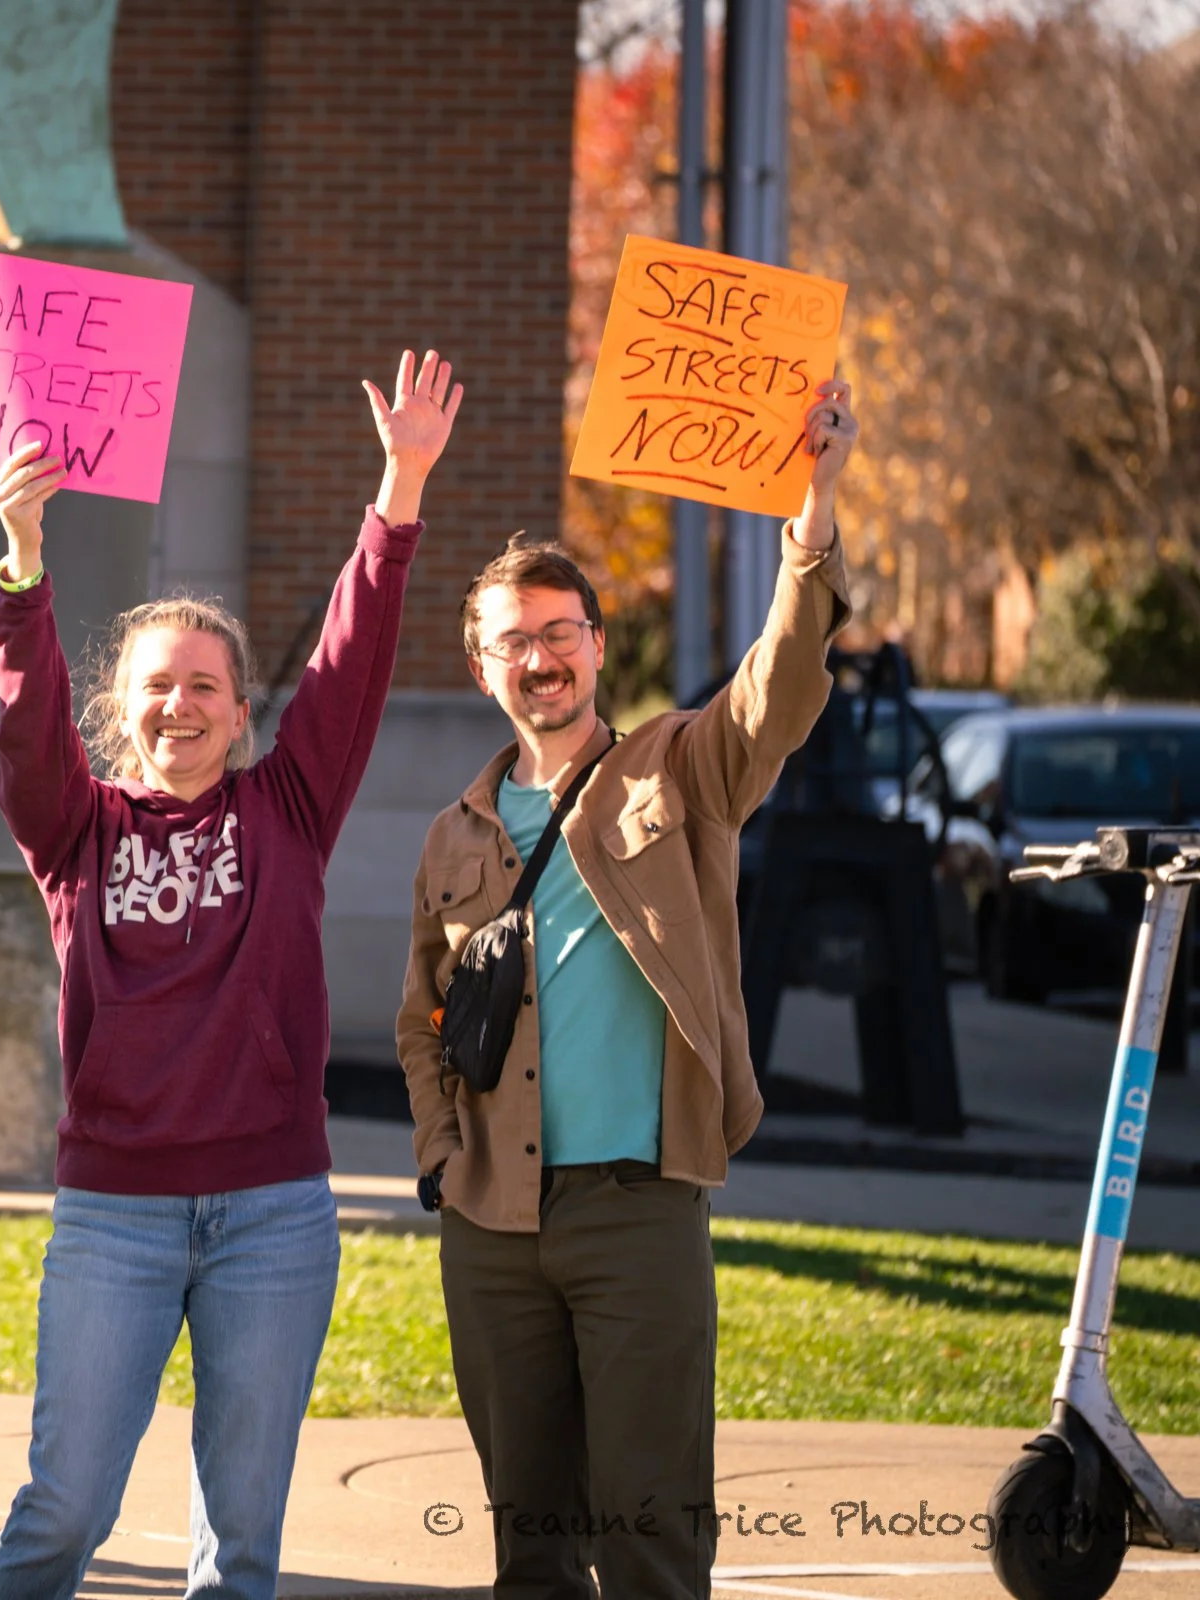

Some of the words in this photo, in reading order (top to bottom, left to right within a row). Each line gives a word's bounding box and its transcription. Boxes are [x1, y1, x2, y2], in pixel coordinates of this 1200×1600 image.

[638, 261, 770, 341] SAFE
[620, 338, 809, 396] STREETS
[610, 407, 806, 488] NOW!
[105, 847, 245, 925] PEOPLE
[1106, 1086, 1150, 1200] BIRD
